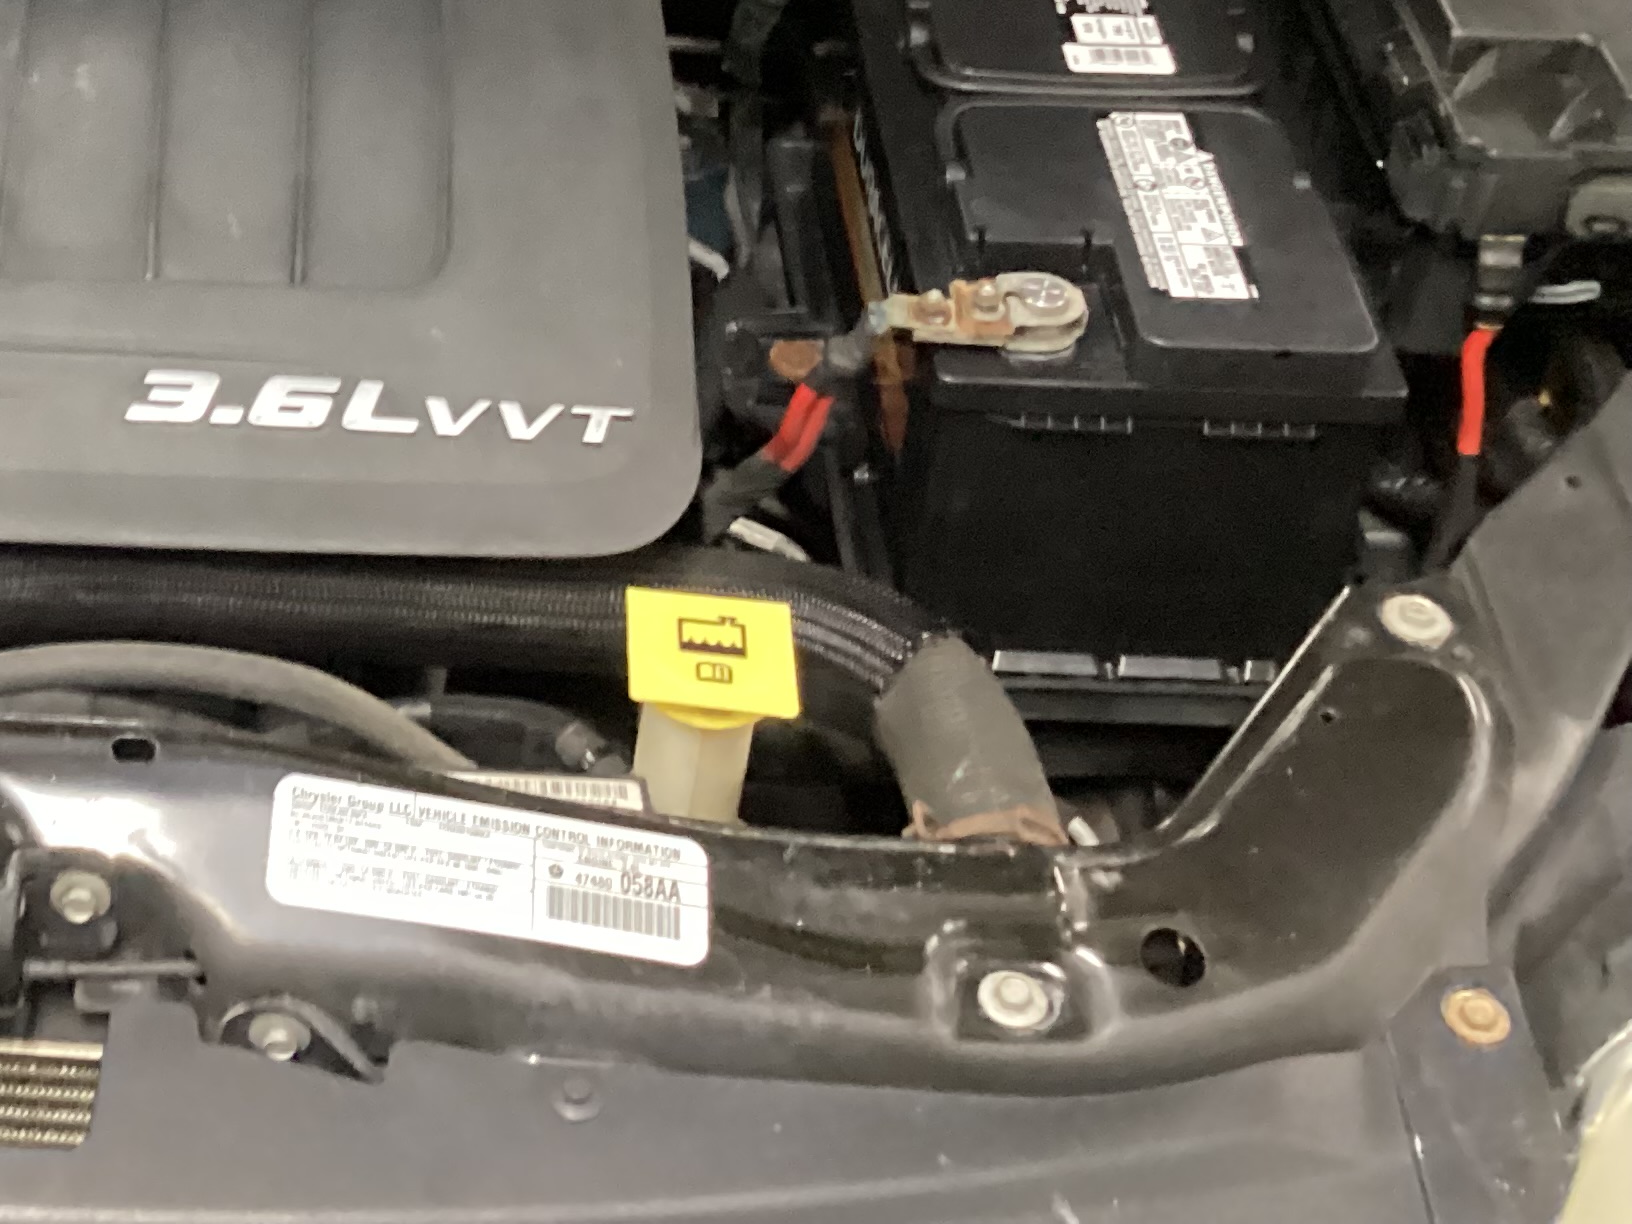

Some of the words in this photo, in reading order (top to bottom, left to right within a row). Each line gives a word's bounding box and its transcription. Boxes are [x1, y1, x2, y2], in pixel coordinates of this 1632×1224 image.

[124, 368, 420, 434] 3.6L
[425, 395, 635, 445] VVT
[292, 786, 342, 806] Chrysler
[347, 795, 385, 815] Group
[389, 802, 412, 817] LLC
[418, 806, 467, 826] VEHICLE
[472, 814, 530, 836] EMISSION
[535, 825, 592, 846] CONTROL
[596, 835, 681, 862] INFORMATION
[620, 870, 682, 903] 058AA
